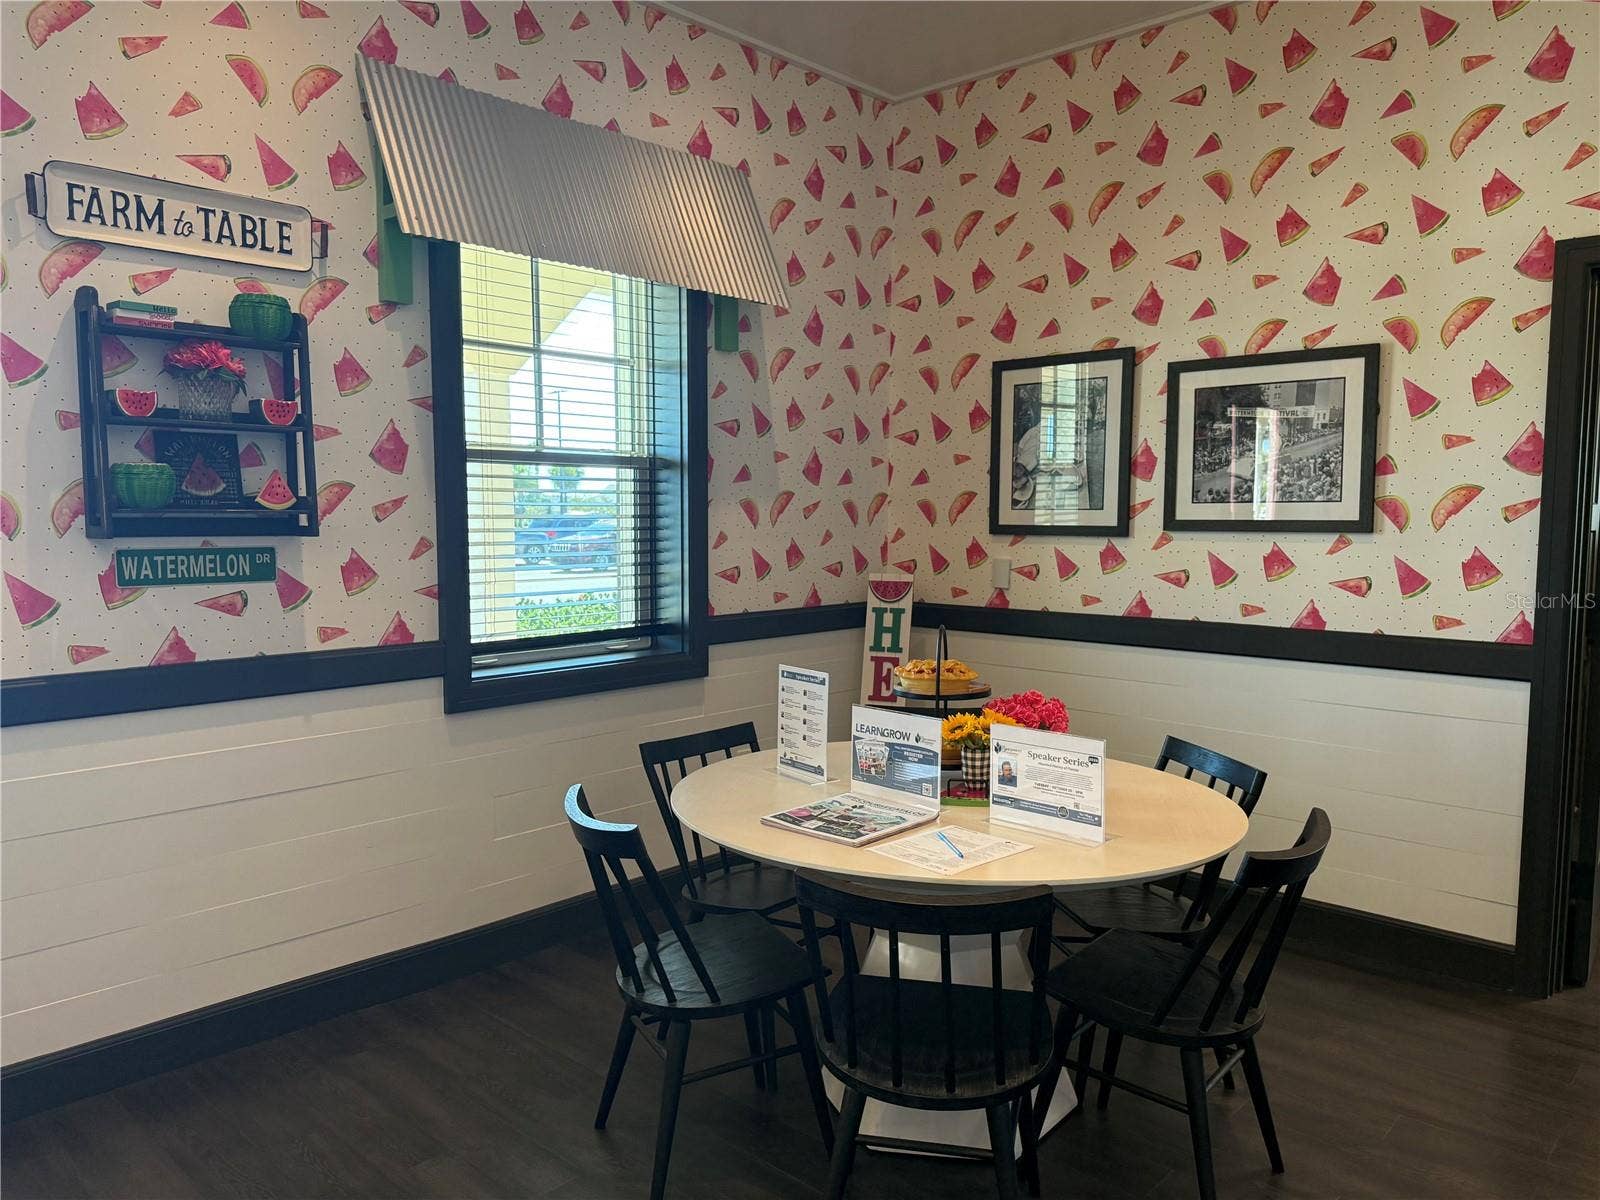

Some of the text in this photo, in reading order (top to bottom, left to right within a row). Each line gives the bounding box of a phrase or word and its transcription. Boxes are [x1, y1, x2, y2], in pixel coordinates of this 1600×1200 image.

[66, 182, 293, 255] FARM to TABLE
[120, 552, 272, 581] WATERMELON DR
[855, 723, 911, 742] LEARNGROW
[1027, 750, 1062, 764] Speaker
[1062, 755, 1090, 768] Series
